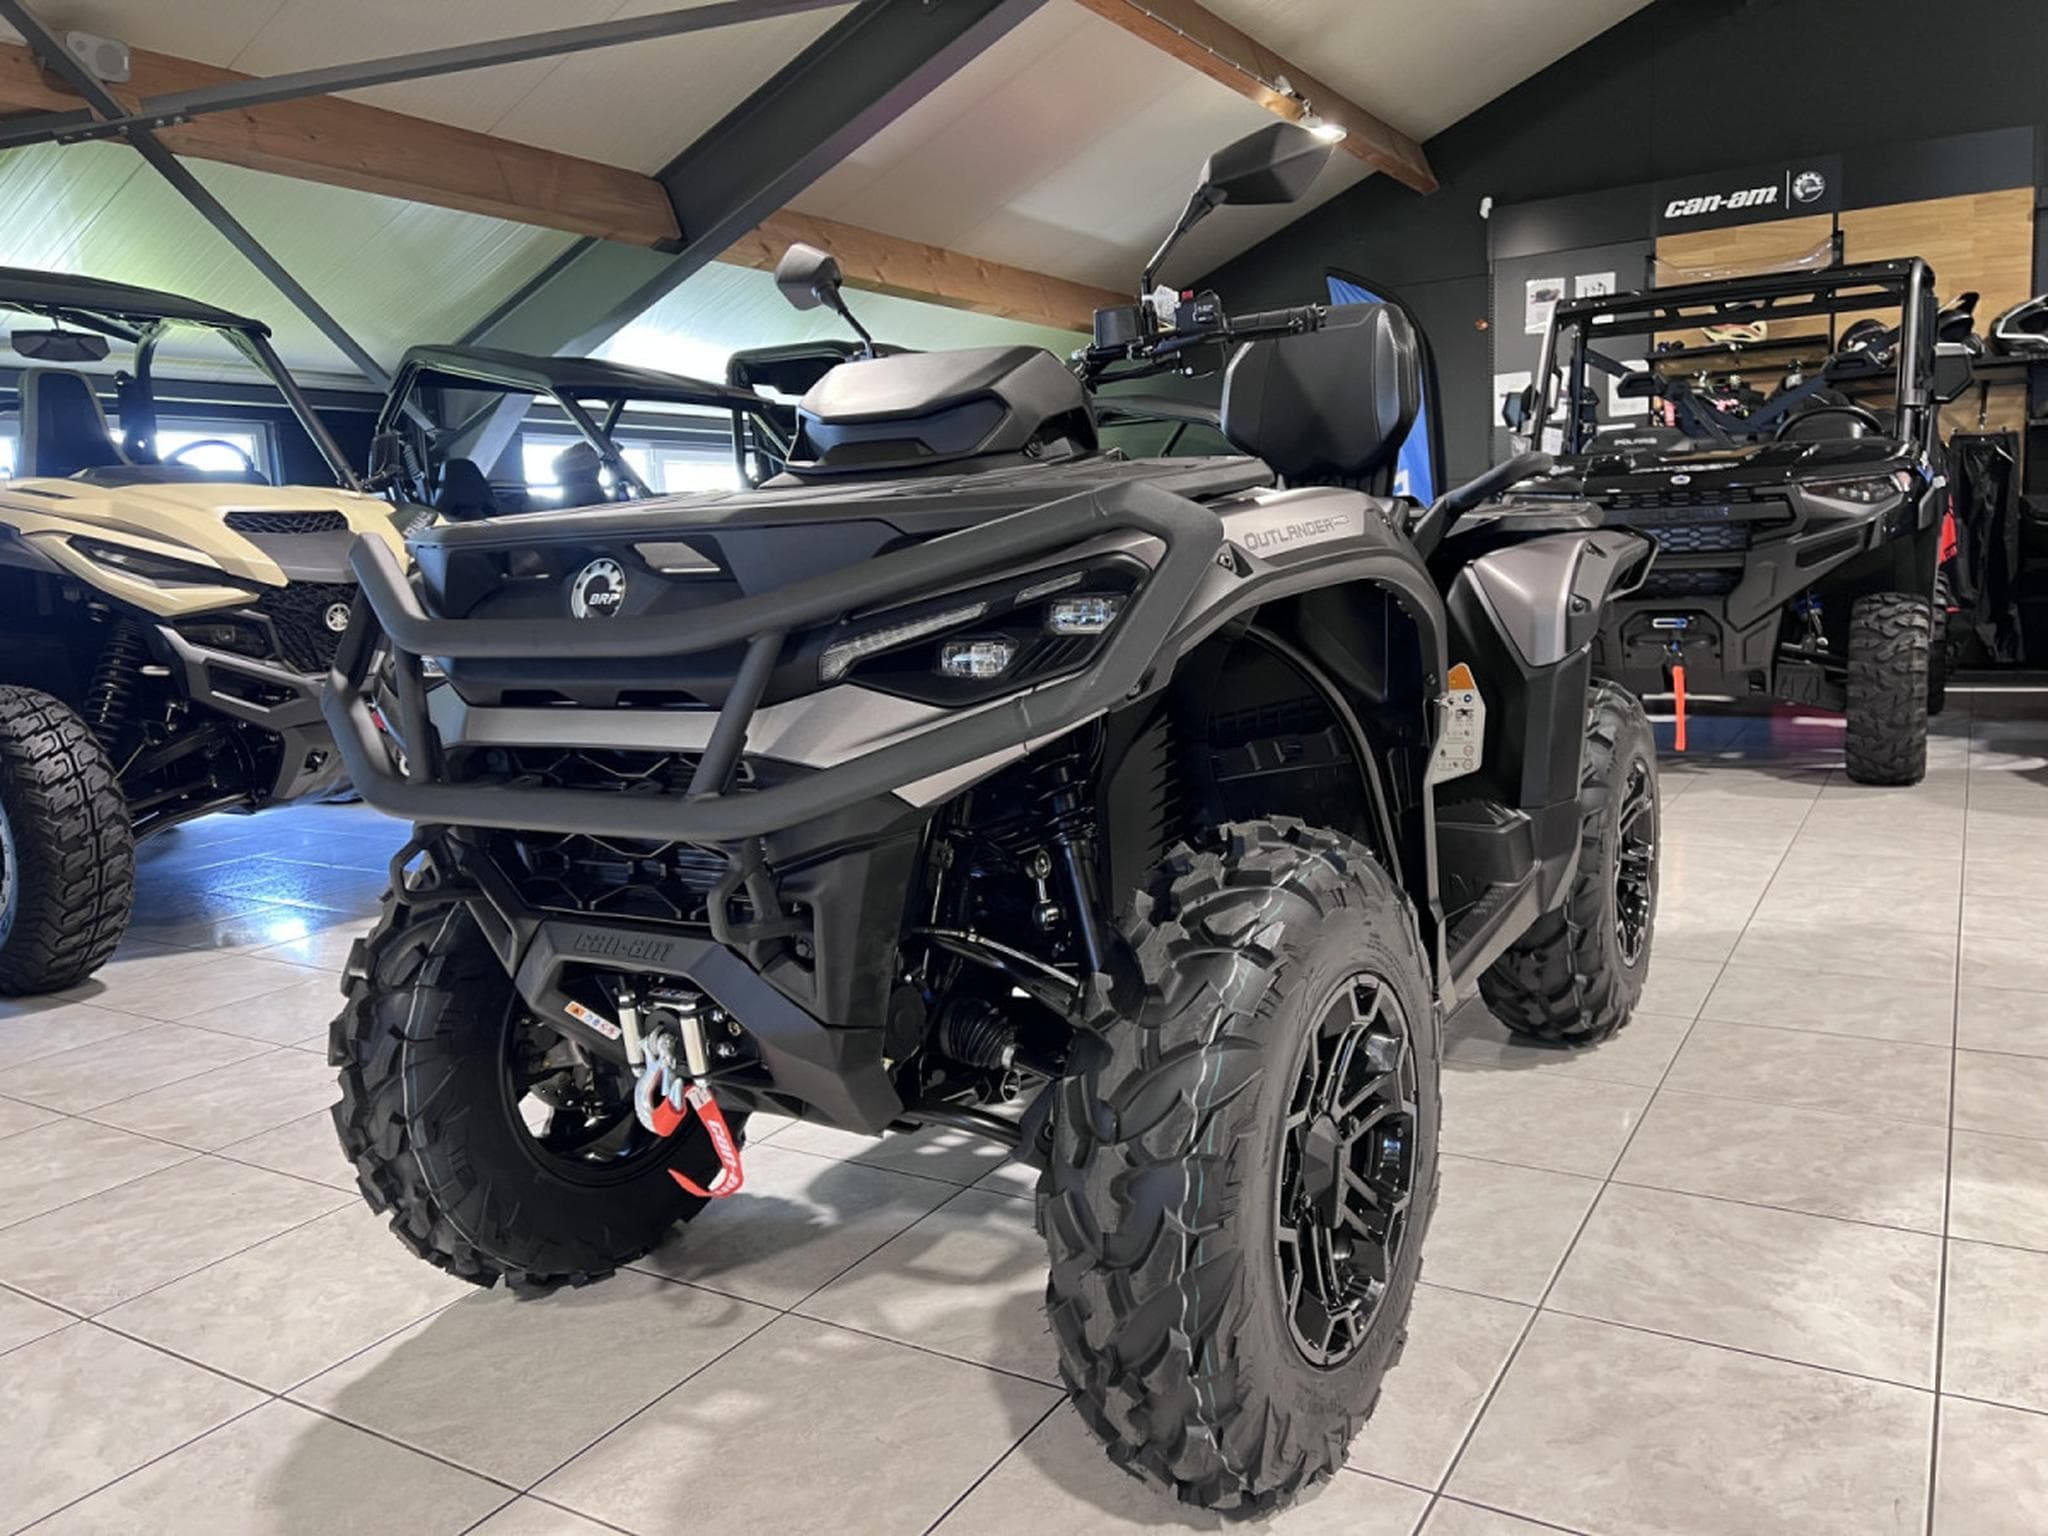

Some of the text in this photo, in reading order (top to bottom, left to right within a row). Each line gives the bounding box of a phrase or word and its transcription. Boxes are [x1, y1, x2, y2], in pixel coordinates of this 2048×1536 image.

[1664, 185, 1778, 219] can-am
[1243, 516, 1335, 551] OUTLANDER
[588, 592, 620, 605] BRP
